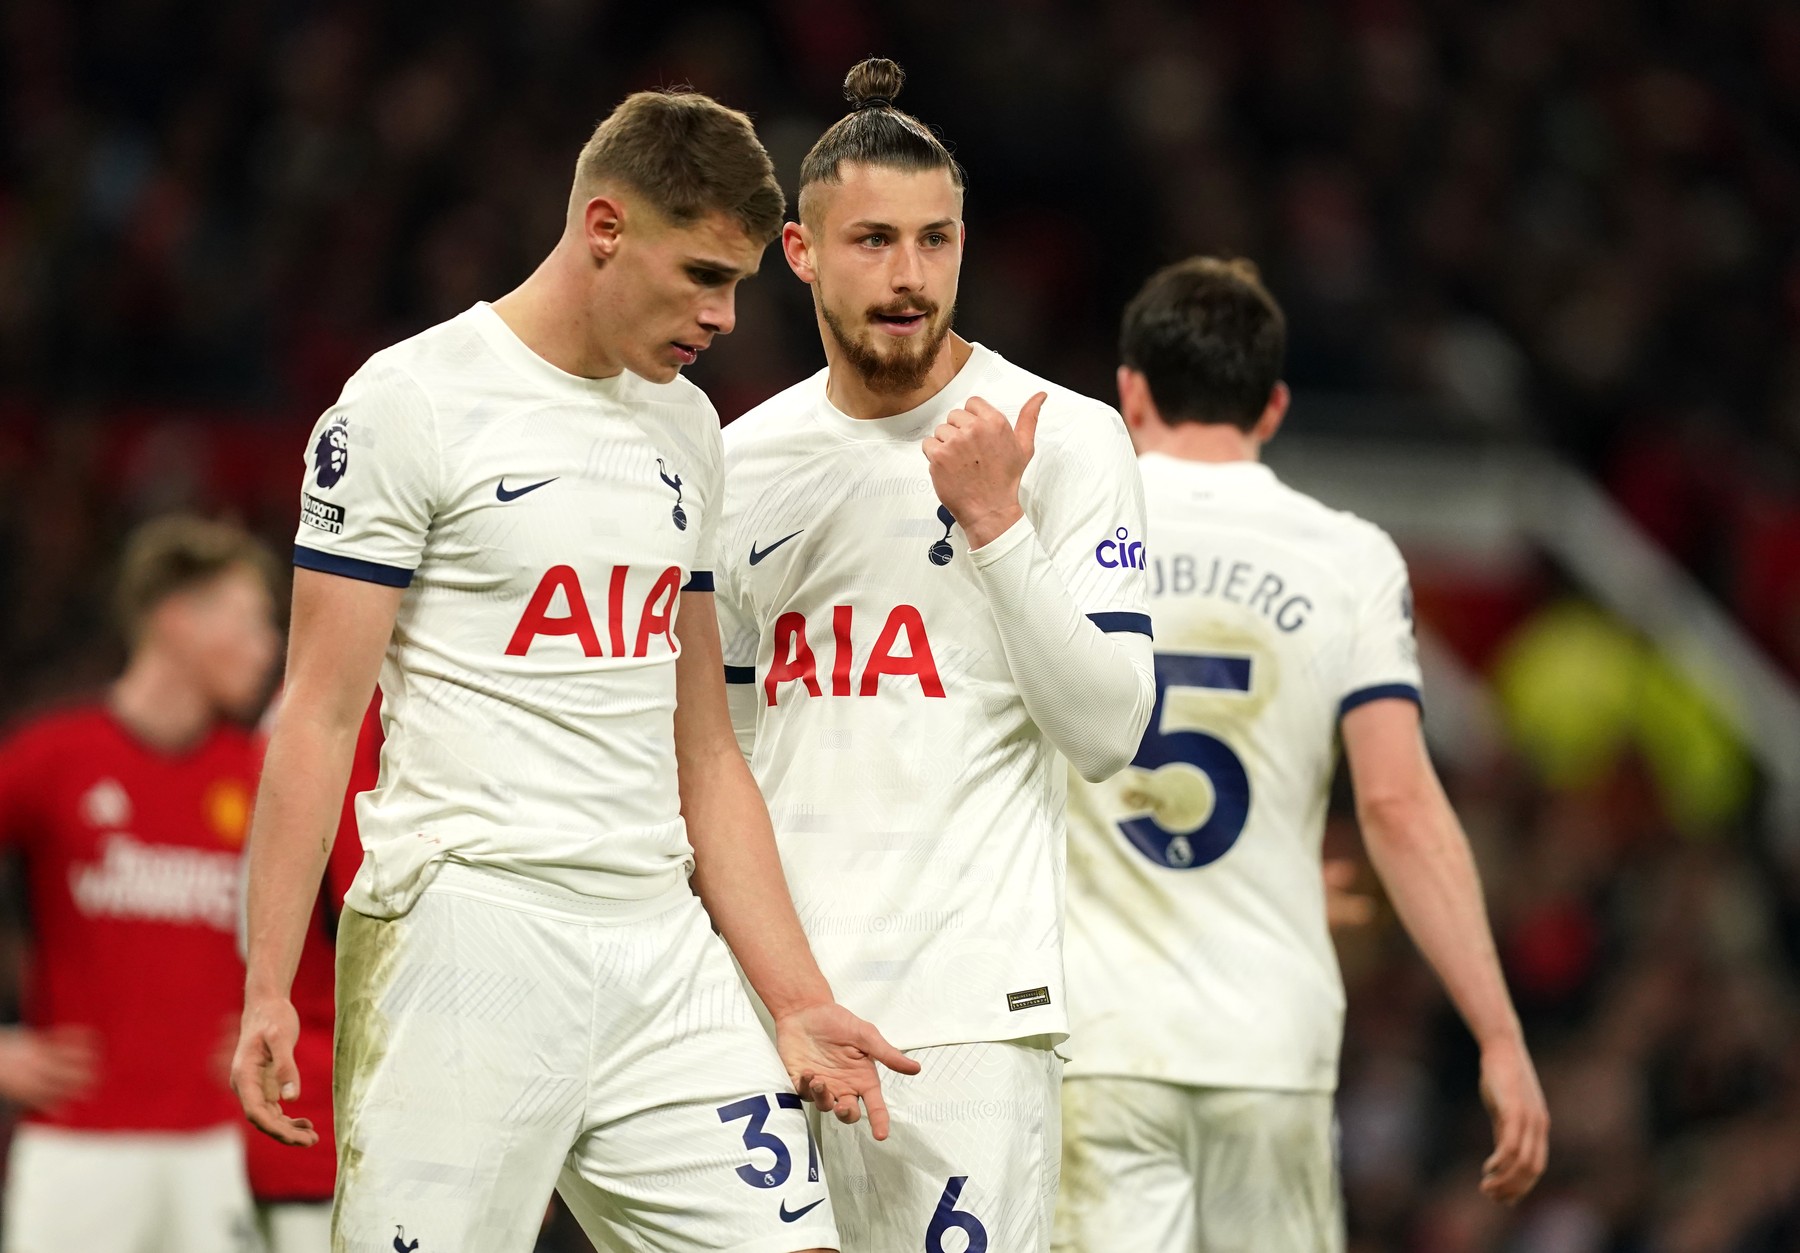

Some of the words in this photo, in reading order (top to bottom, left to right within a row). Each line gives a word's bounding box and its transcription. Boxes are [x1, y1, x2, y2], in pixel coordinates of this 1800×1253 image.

[1095, 526, 1147, 571] cin
[504, 564, 682, 658] AIA
[764, 604, 947, 707] AIA
[1116, 652, 1252, 869] 5
[925, 1175, 988, 1253] 6
